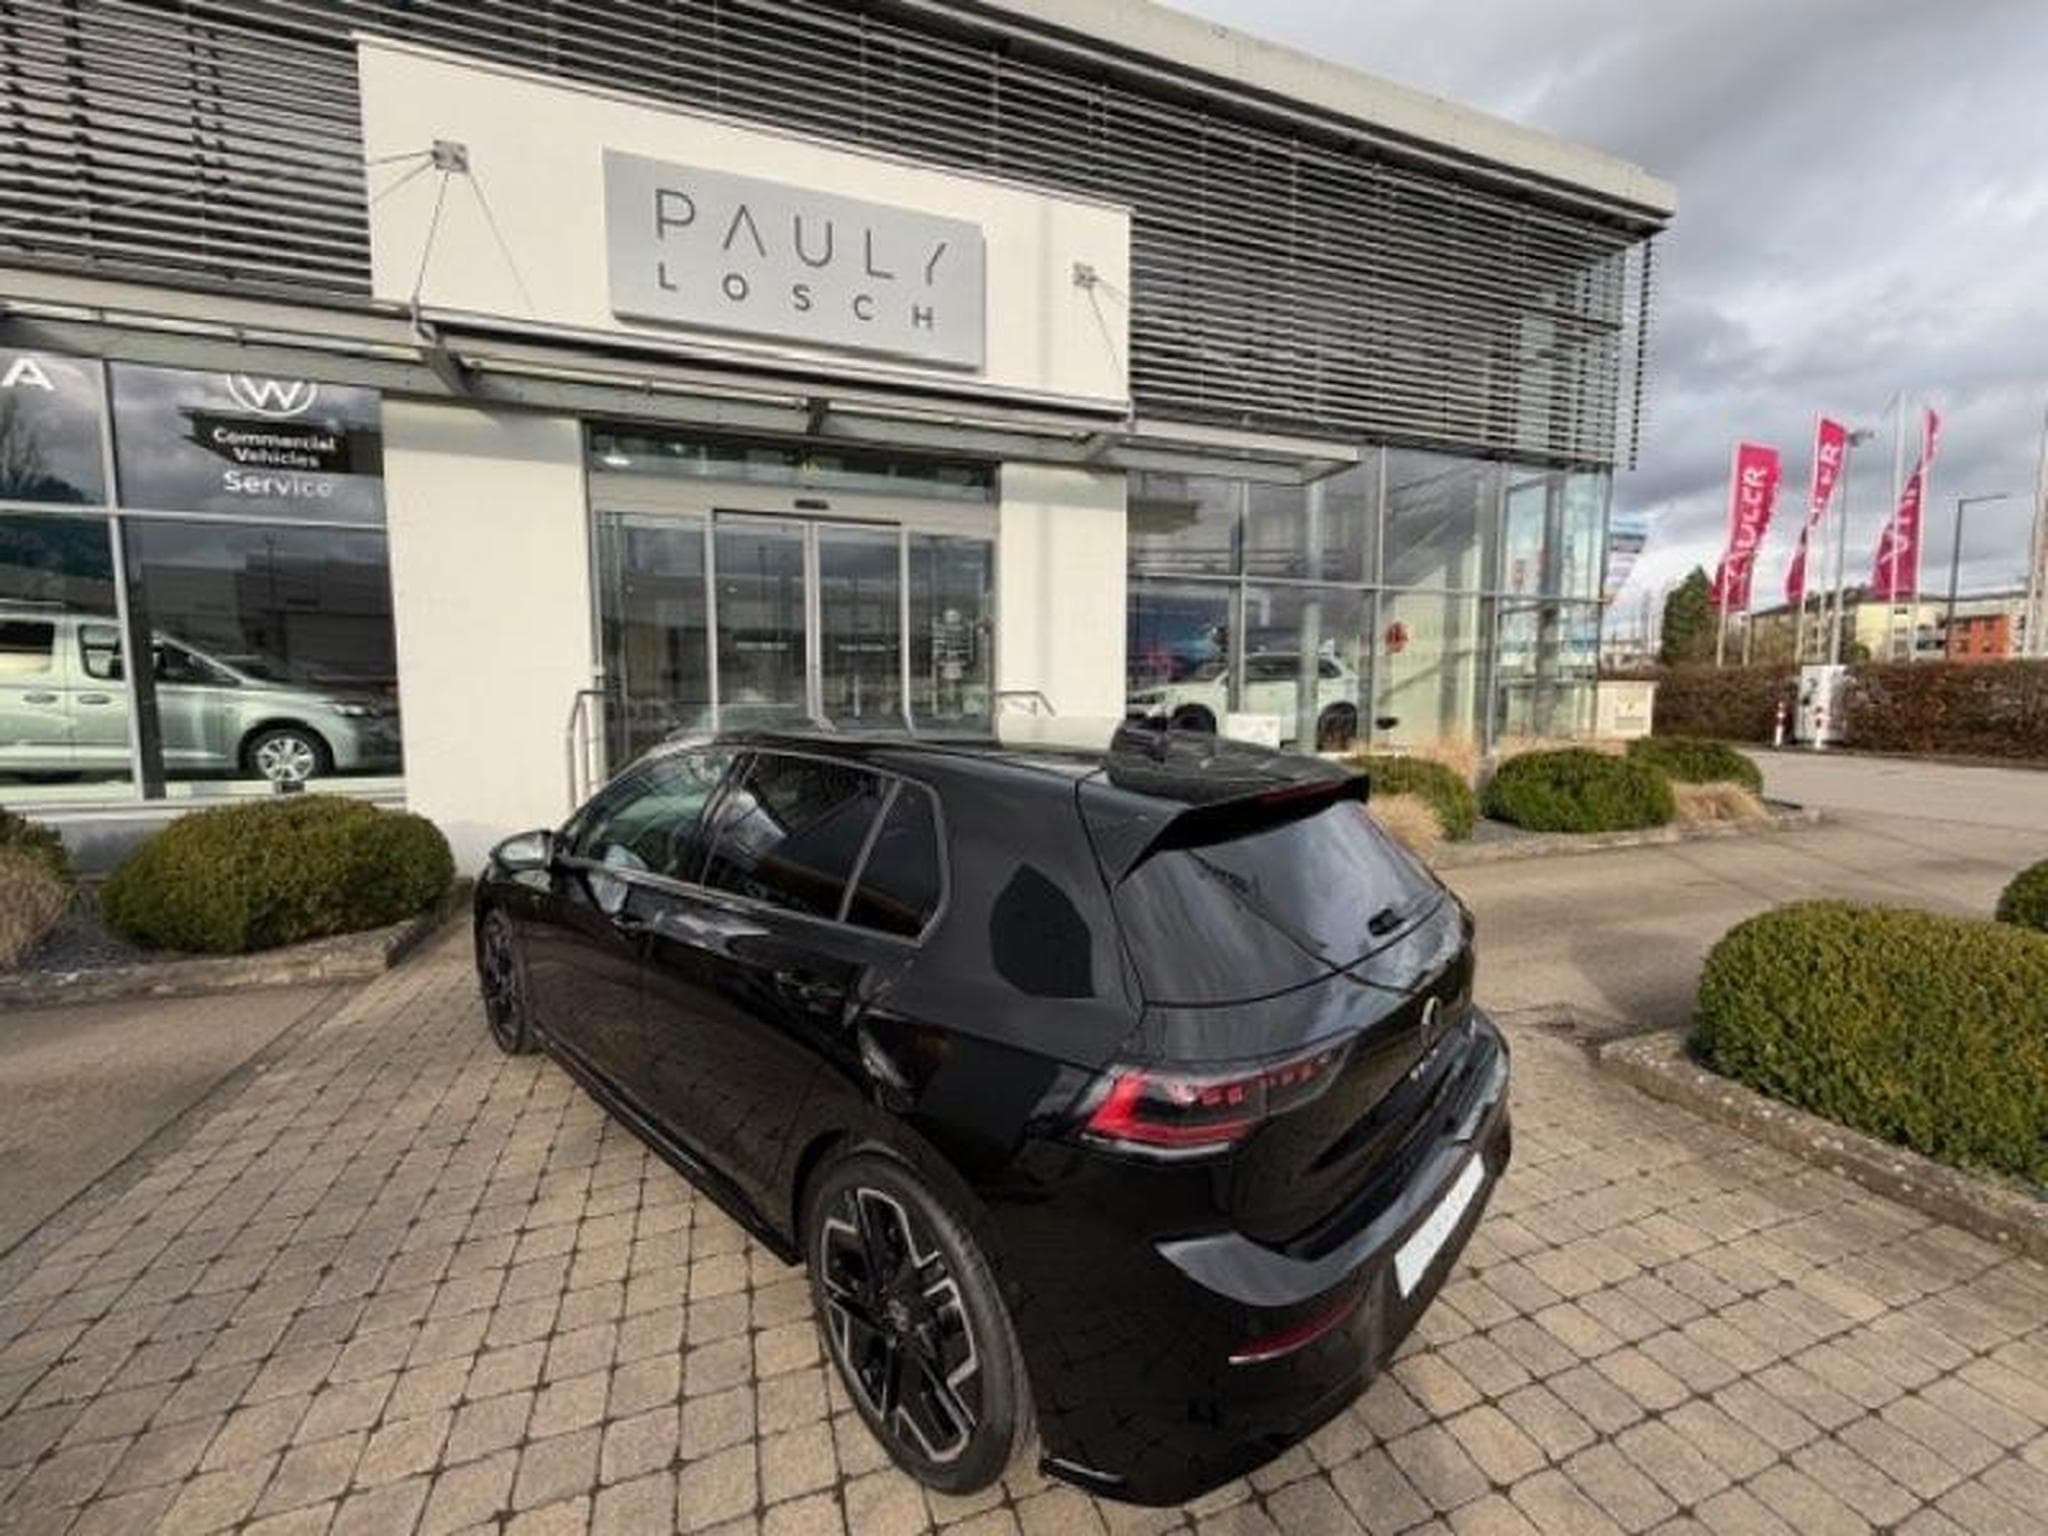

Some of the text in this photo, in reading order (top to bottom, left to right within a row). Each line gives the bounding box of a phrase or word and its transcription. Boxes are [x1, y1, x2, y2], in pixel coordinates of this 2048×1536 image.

[655, 187, 947, 286] PAULY
[657, 261, 934, 329] LOSCH
[213, 426, 337, 451] Commercial
[232, 447, 320, 468] Vehicles
[223, 469, 333, 497] Service
